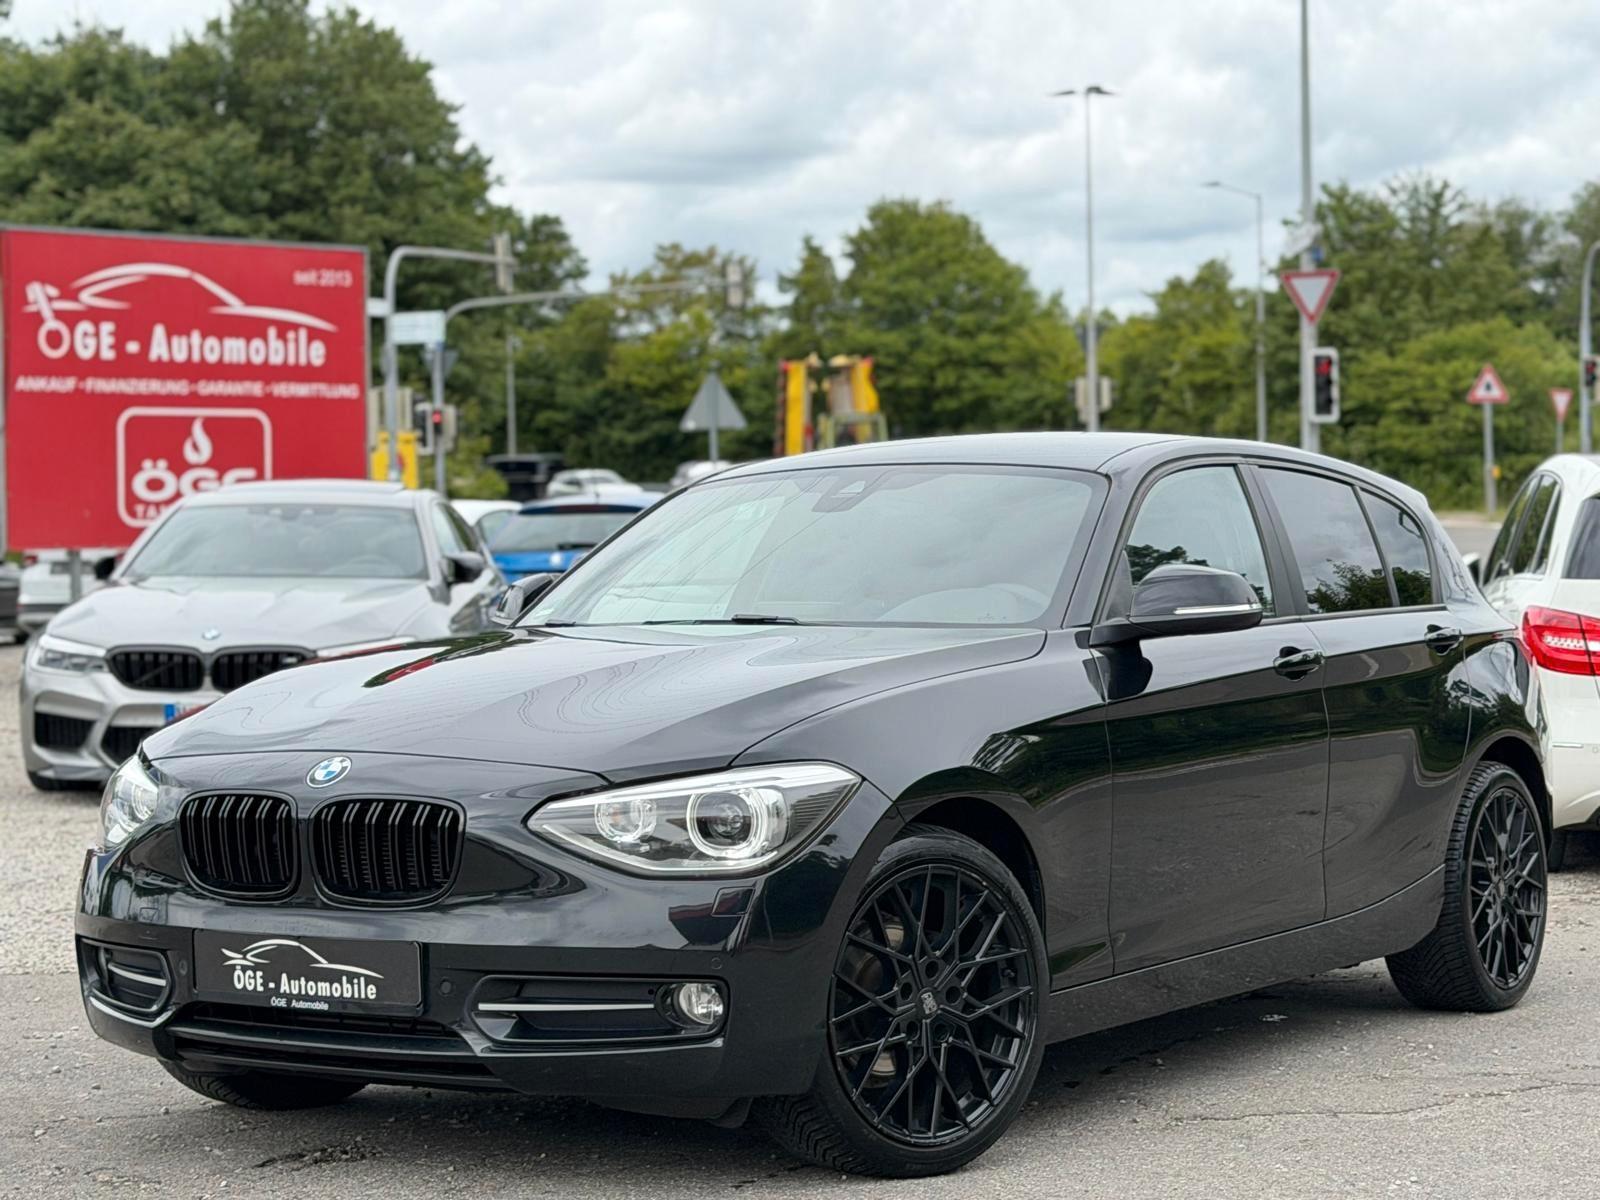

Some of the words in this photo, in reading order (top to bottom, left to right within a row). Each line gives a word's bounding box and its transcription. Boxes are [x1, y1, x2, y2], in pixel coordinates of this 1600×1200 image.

[148, 322, 327, 368] Automobile
[15, 375, 77, 394] ANKAUF
[85, 375, 191, 397] FINANZIERUNG
[196, 379, 264, 398] GARANTIE
[233, 965, 264, 992] ÖGE
[280, 972, 377, 1000] Automobile
[291, 999, 329, 1011] Automobile
